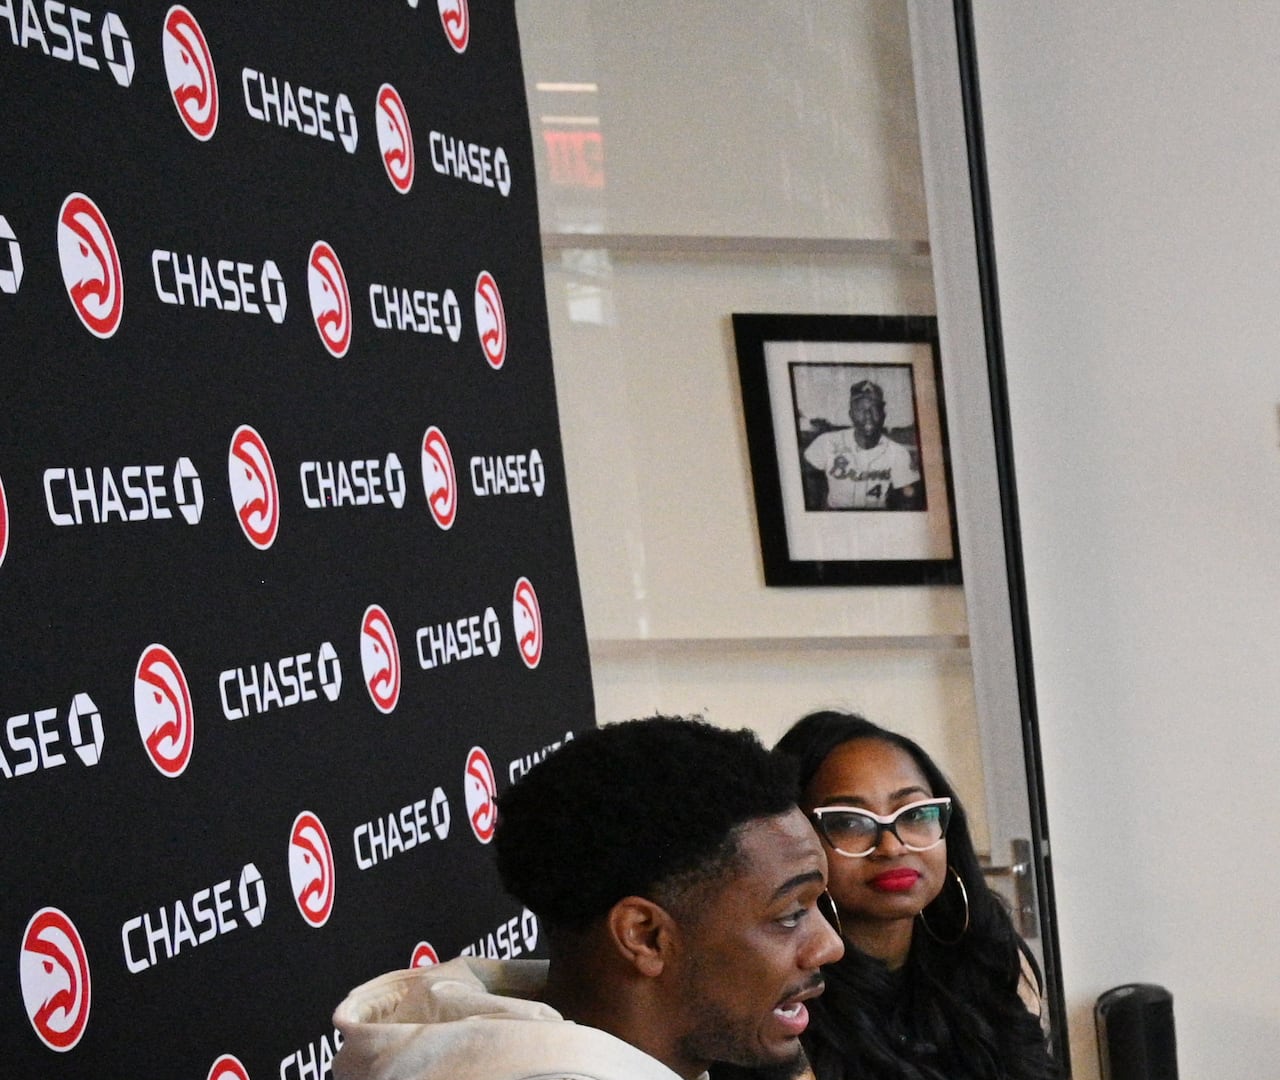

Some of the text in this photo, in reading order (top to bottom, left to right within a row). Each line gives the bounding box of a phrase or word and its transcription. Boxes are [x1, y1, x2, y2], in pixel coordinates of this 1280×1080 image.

[0, 0, 100, 70] HASE
[241, 67, 336, 142] CHASE
[429, 131, 495, 187] CHASE
[152, 249, 261, 315] CHASE
[369, 284, 444, 335] CHASE
[43, 466, 173, 526] CHASE
[300, 459, 384, 508] CHASE
[470, 455, 530, 497] CHASE
[416, 615, 485, 670] CHASE
[219, 653, 318, 721] CHASE
[354, 799, 431, 870] CHASE
[122, 880, 239, 974] CHASE
